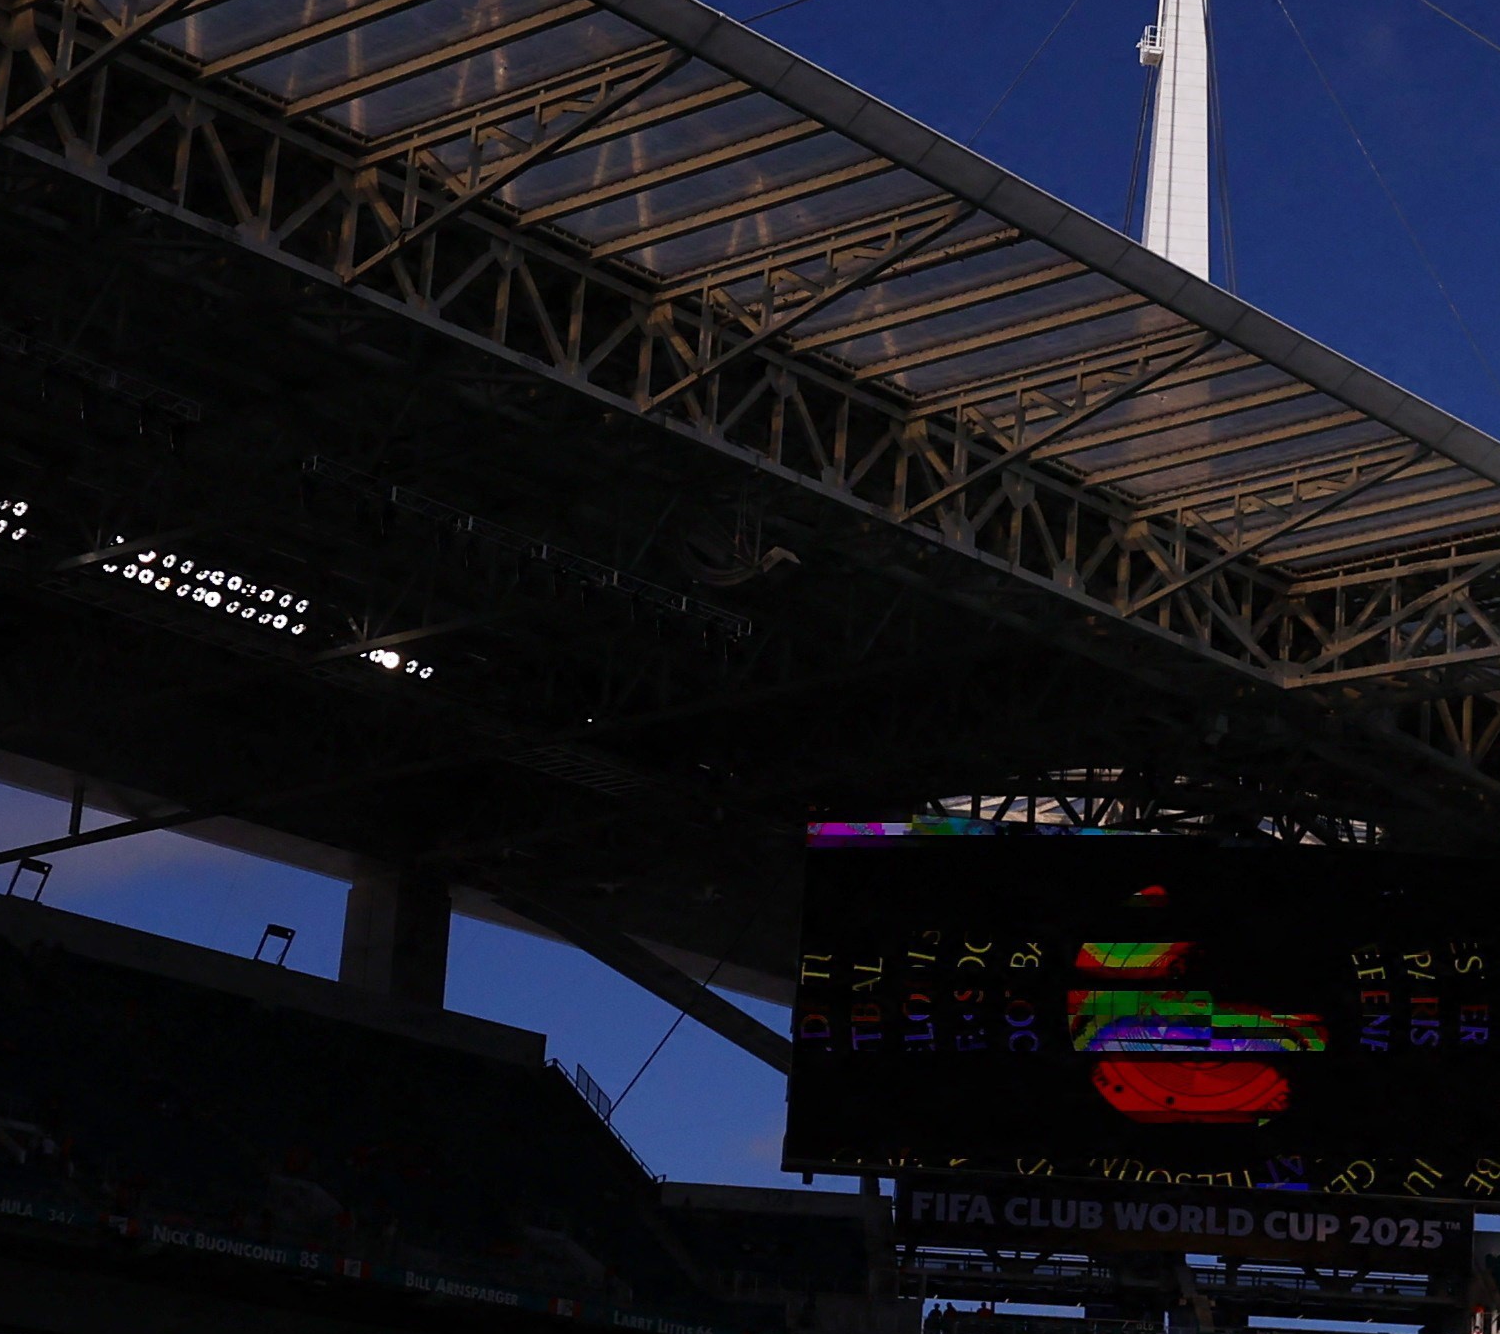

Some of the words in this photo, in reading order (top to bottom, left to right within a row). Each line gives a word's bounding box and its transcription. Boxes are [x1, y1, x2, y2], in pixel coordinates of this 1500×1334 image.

[910, 1190, 996, 1225] FIFA
[1004, 1195, 1103, 1230] CLUB
[1112, 1199, 1255, 1238] WORLD
[1264, 1212, 1340, 1243] CUP
[152, 1223, 191, 1246] NICK
[194, 1232, 288, 1266] BUONICONTI
[298, 1251, 320, 1269] 85
[405, 1270, 432, 1292] BILL
[435, 1276, 520, 1308] ARNSPARGER
[613, 1310, 654, 1332] LARRY
